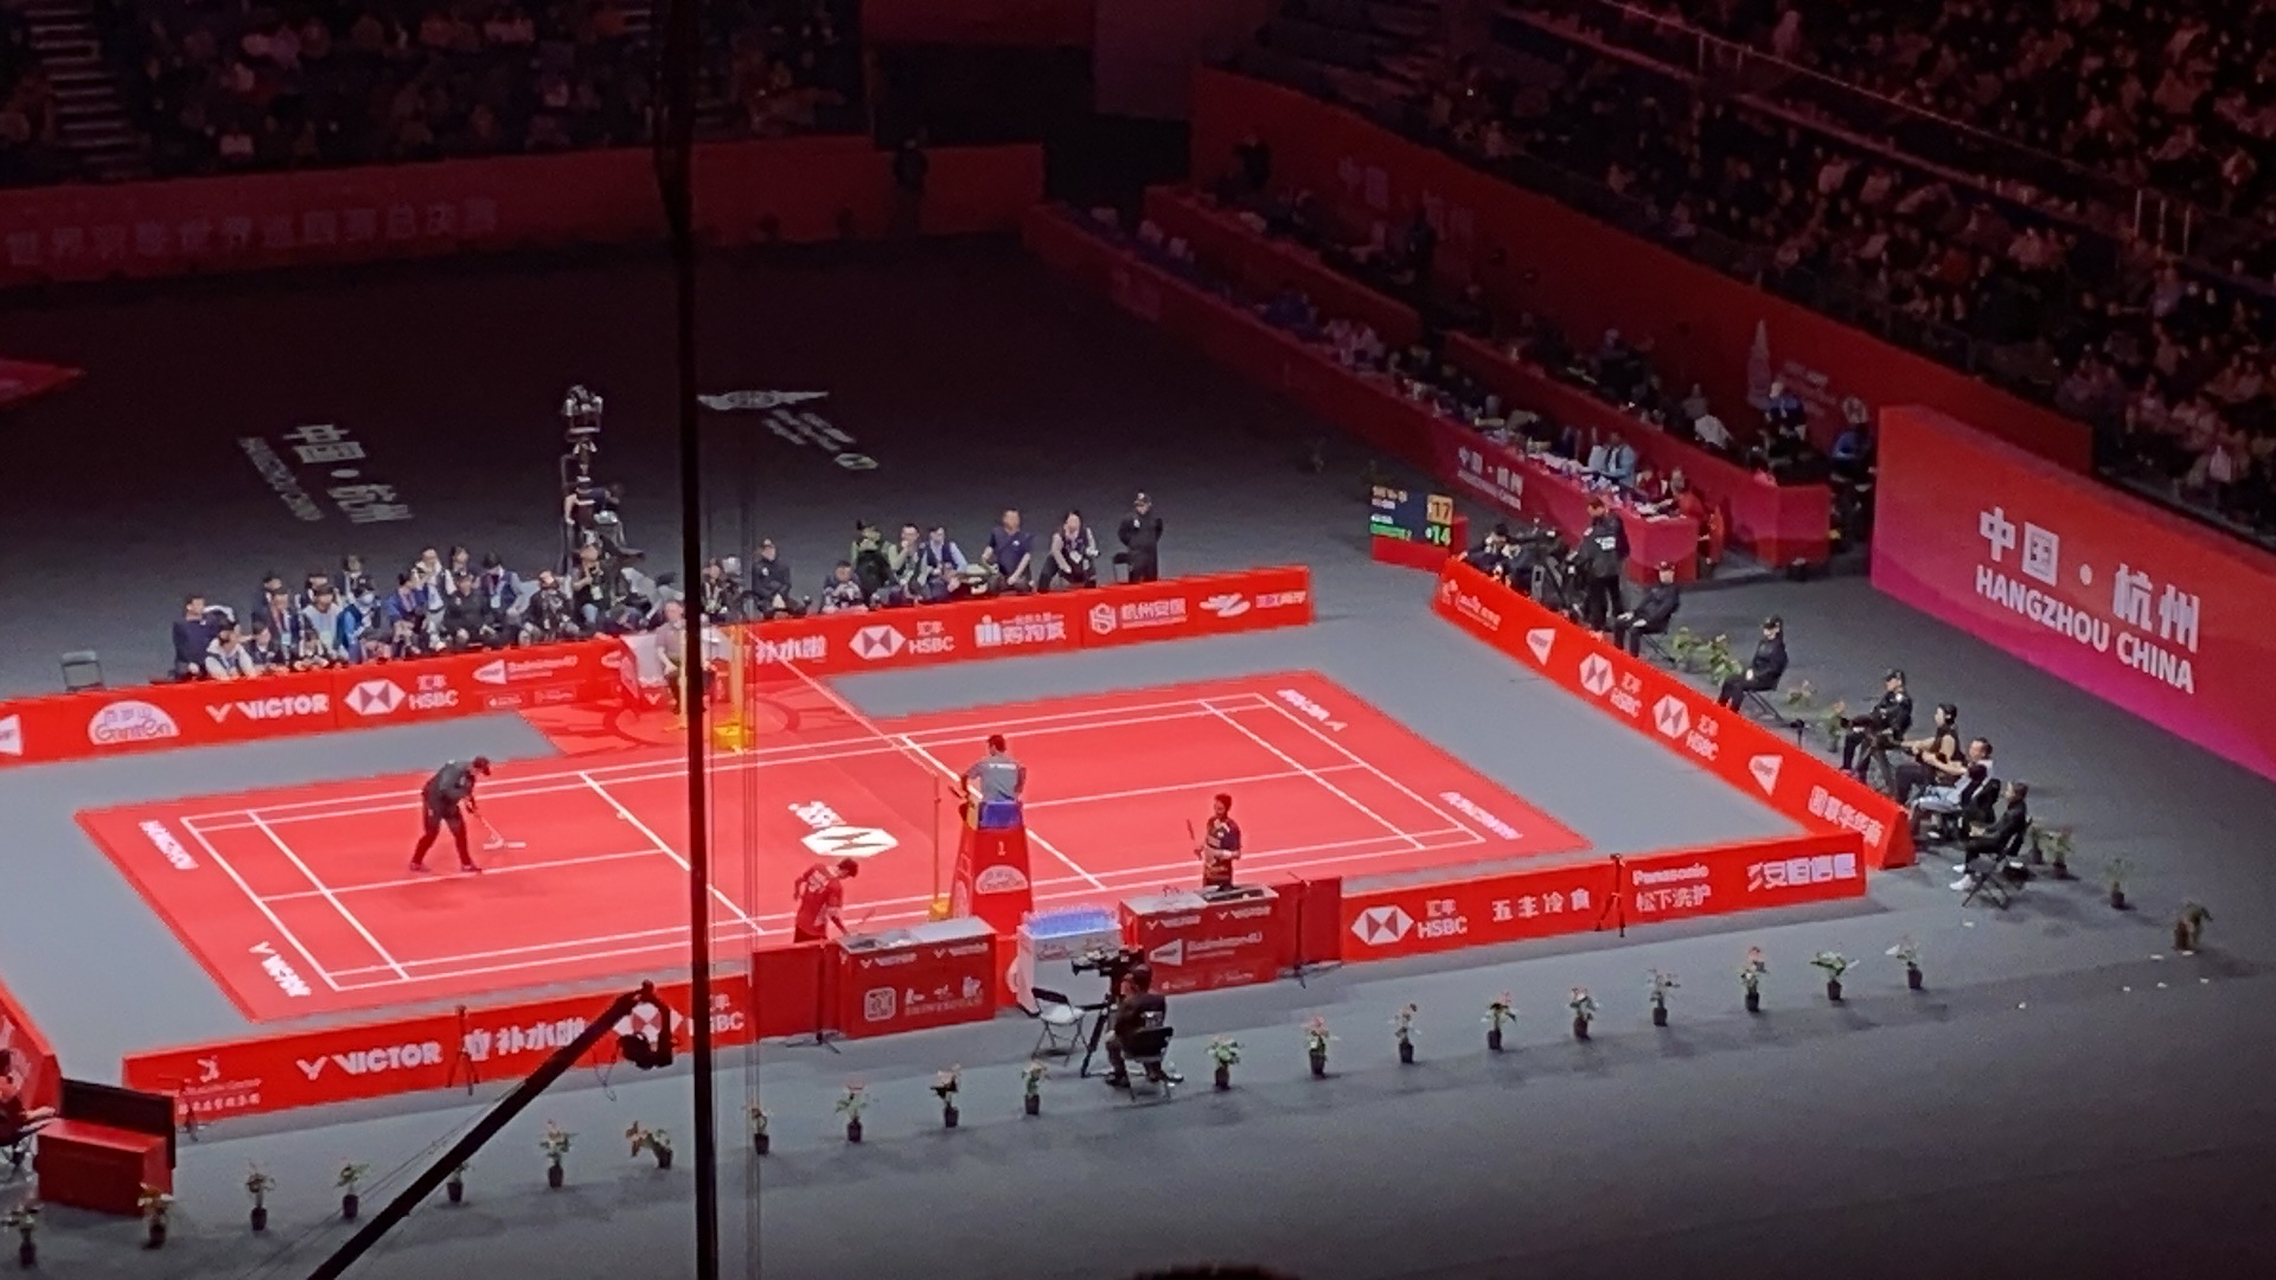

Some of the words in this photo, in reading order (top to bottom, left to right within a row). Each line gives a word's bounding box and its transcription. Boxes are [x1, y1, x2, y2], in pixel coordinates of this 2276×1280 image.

[1432, 525, 1452, 546] 14
[1978, 505, 2201, 653] 中国·杭州
[1976, 565, 2110, 652] HANGZHOU
[2117, 632, 2195, 694] CHINA
[909, 636, 955, 654] HSBC
[236, 693, 330, 719] VICTOR
[408, 690, 459, 710] HSBC
[1610, 686, 1642, 718] HSBC
[1686, 729, 1719, 761] HSBC
[1632, 862, 1710, 886] Panasonic
[1636, 883, 1712, 913] 松下洗护
[1417, 915, 1468, 939] HSBC
[331, 1040, 443, 1075] VICTOR
